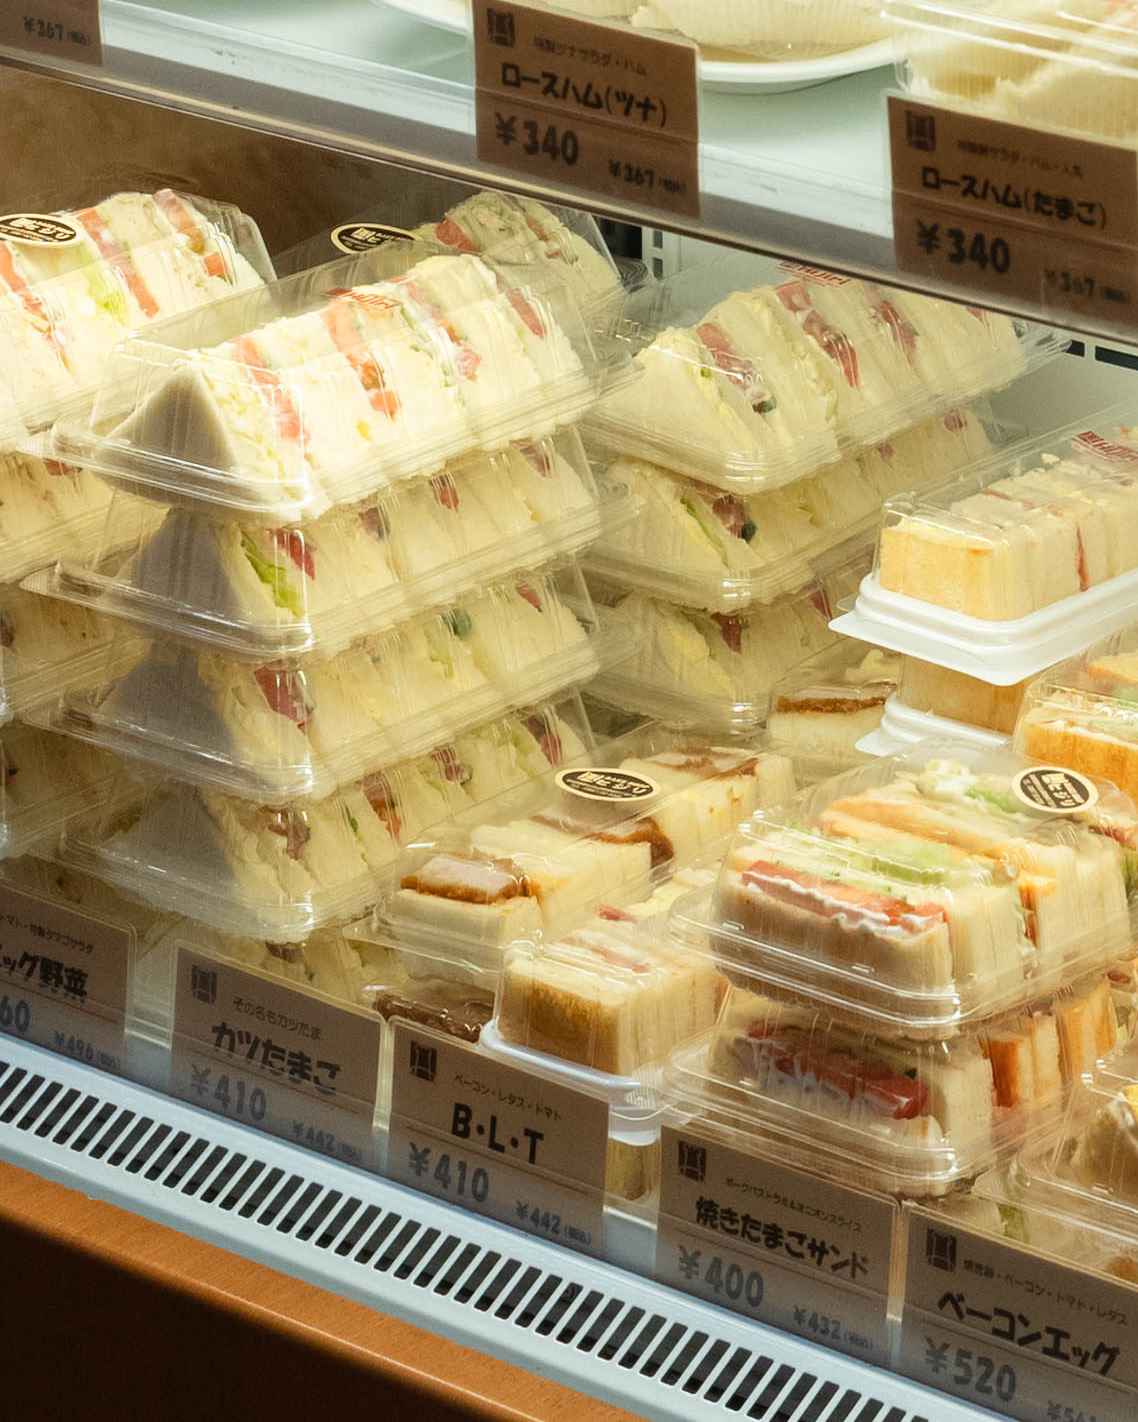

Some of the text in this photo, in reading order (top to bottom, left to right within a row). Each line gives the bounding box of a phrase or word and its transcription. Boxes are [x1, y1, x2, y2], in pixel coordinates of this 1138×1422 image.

[501, 61, 667, 127] ロースハム(ツナ)
[494, 111, 579, 166] ¥340
[921, 166, 1107, 230] ロースハム(たまご)
[916, 219, 1011, 274] ¥340
[0, 948, 88, 1000] ッグ野菜
[212, 1021, 340, 1095] カツたまご
[191, 1063, 267, 1121] ¥410
[408, 1141, 489, 1203] ¥410
[515, 1201, 561, 1235] ¥442
[696, 1195, 869, 1278] 焼きたまごサンド
[677, 1245, 765, 1307] ¥400
[793, 1306, 841, 1340] ¥432
[937, 1291, 1121, 1376] ベーコンエッグ
[924, 1337, 1017, 1403] ¥520
